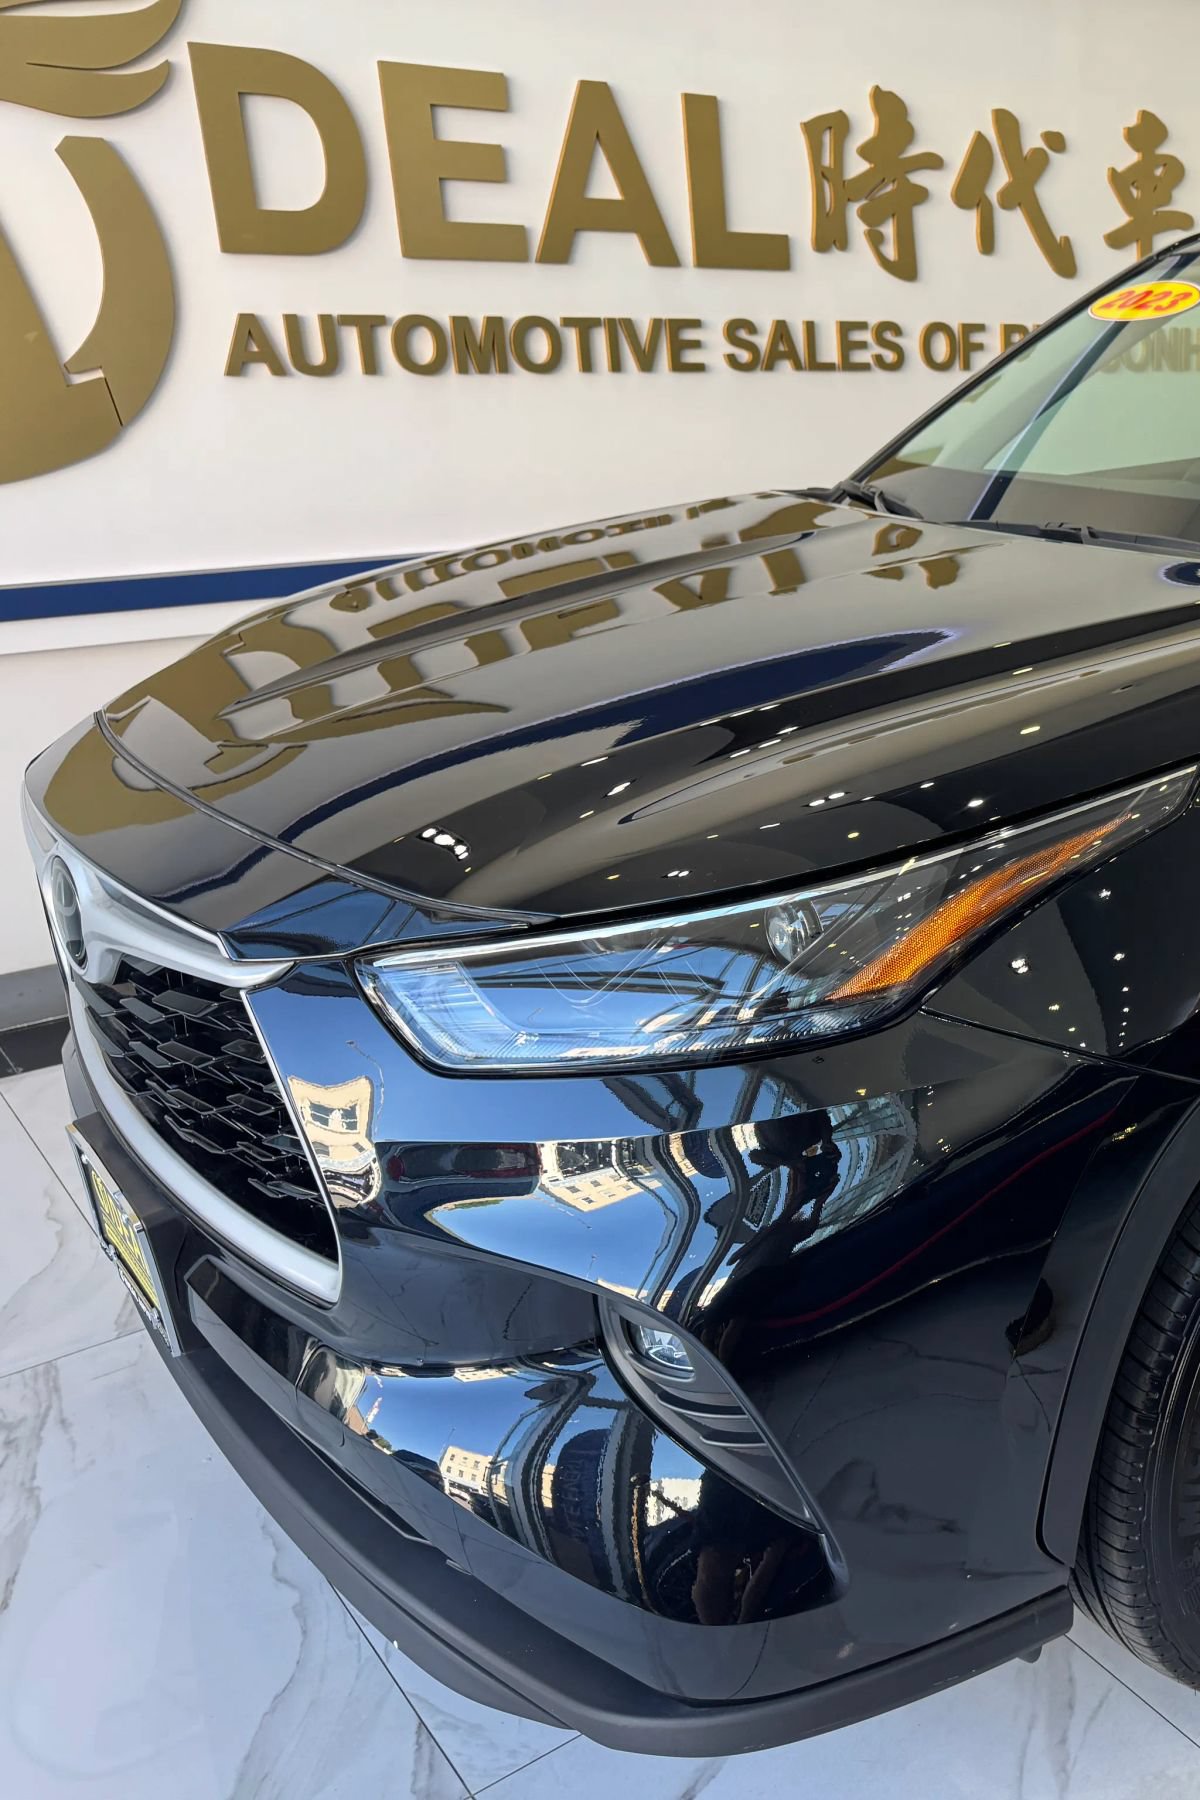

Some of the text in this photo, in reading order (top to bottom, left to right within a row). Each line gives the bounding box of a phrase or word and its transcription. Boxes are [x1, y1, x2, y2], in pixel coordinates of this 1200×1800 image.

[187, 42, 790, 271] DEAL
[1100, 289, 1193, 312] 2023
[224, 312, 706, 378] AUTOMOTIVE
[722, 318, 905, 373] SALES
[918, 321, 986, 372] OF
